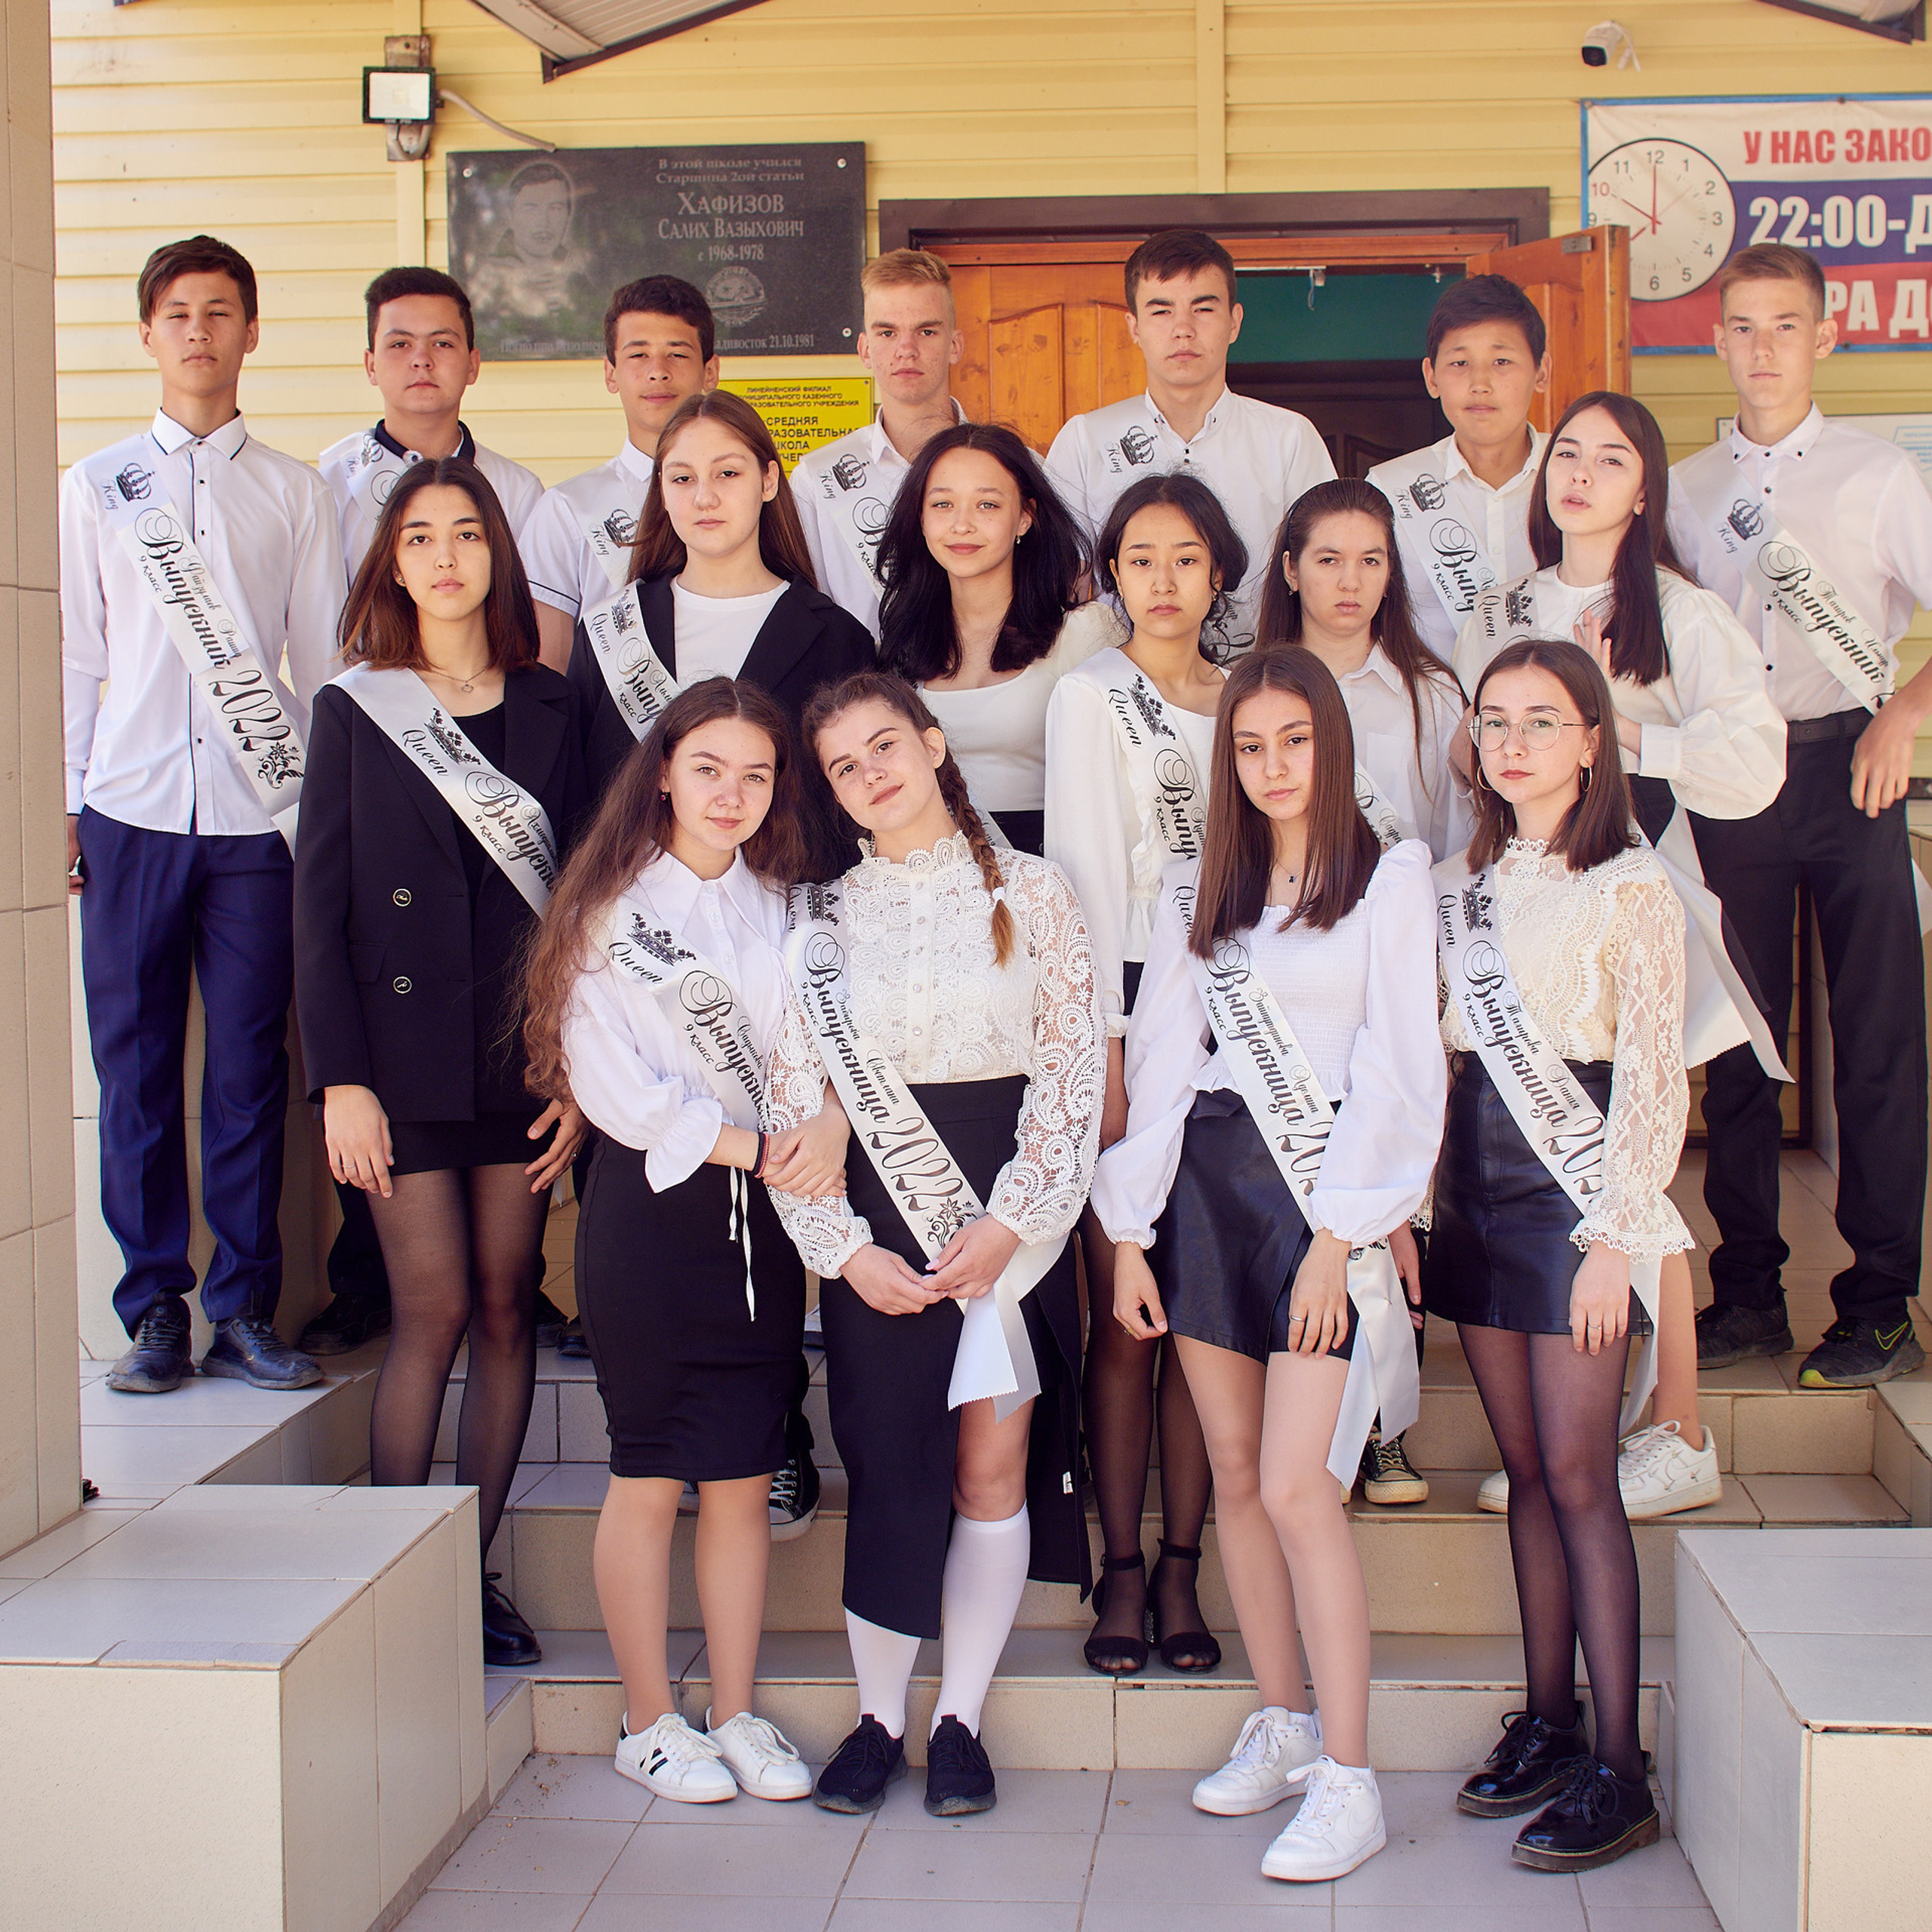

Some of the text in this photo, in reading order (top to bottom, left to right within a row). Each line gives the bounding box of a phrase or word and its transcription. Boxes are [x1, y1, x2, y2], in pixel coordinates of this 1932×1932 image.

[1647, 150, 1665, 164] 12
[1743, 131, 1762, 165] У
[1770, 129, 1835, 164] НАС
[656, 172, 728, 186] Старшина
[758, 171, 804, 181] статьи
[659, 158, 668, 169] В
[671, 158, 703, 169] этой
[706, 158, 751, 168] школе
[1614, 161, 1629, 174] 11
[1684, 158, 1690, 172] 1
[1592, 182, 1610, 196] 10
[1706, 180, 1715, 195] 2
[1712, 211, 1723, 226] 3
[708, 243, 764, 261] 1968-1978
[1704, 243, 1714, 257] 4
[1650, 275, 1660, 290] 6
[1682, 267, 1692, 281] 5
[769, 334, 815, 349] 21.10.1981
[143, 565, 163, 593] класс
[1436, 573, 1455, 601] класс
[1478, 595, 1500, 639] Queen
[1758, 541, 1885, 684] Выпускник
[1769, 589, 1802, 625] 9 класс
[134, 507, 291, 752] Выпускник 2022
[591, 613, 611, 655] Queen
[619, 692, 637, 718] класс
[1109, 688, 1142, 749] Queen
[401, 729, 449, 777] Queen
[479, 825, 506, 854] класс
[1156, 808, 1171, 841] класс
[1436, 894, 1459, 948] Queen
[608, 942, 664, 984] Queen
[800, 981, 820, 1027] 9 класс
[1208, 997, 1226, 1030] класс
[1463, 993, 1484, 1038] 9 класс
[1205, 937, 1305, 1126] Выпускница
[1463, 940, 1569, 1128] Выпускница
[690, 1034, 715, 1065] класс
[805, 932, 963, 1211] Выпускница 2022
